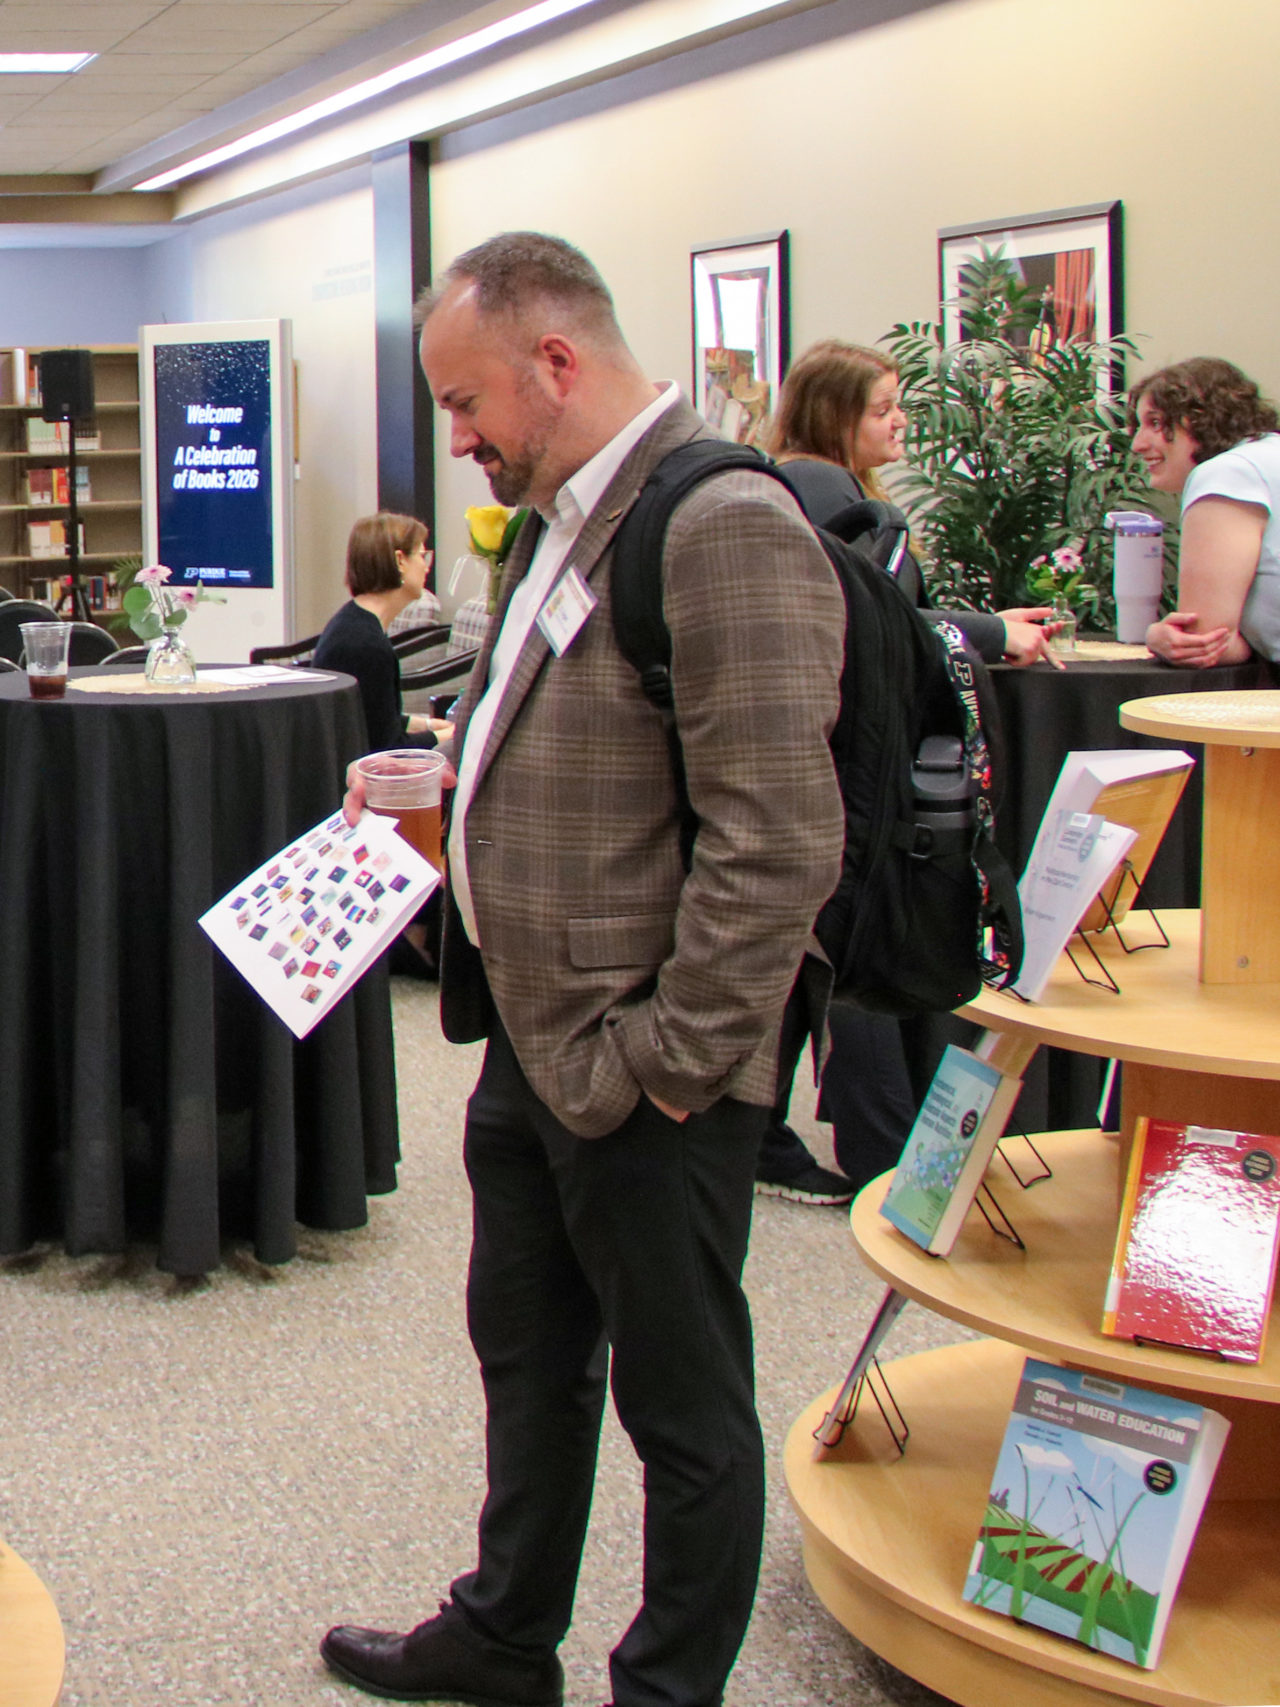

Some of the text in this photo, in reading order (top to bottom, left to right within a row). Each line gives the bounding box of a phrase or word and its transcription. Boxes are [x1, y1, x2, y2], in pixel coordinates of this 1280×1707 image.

[187, 404, 243, 424] Welcome
[209, 427, 220, 442] to
[174, 445, 257, 466] A Celebration
[173, 469, 259, 489] of Books 2026
[1033, 1389, 1058, 1406] SOIL
[1076, 1401, 1118, 1424] WATER
[1118, 1413, 1188, 1445] EDUCATION
